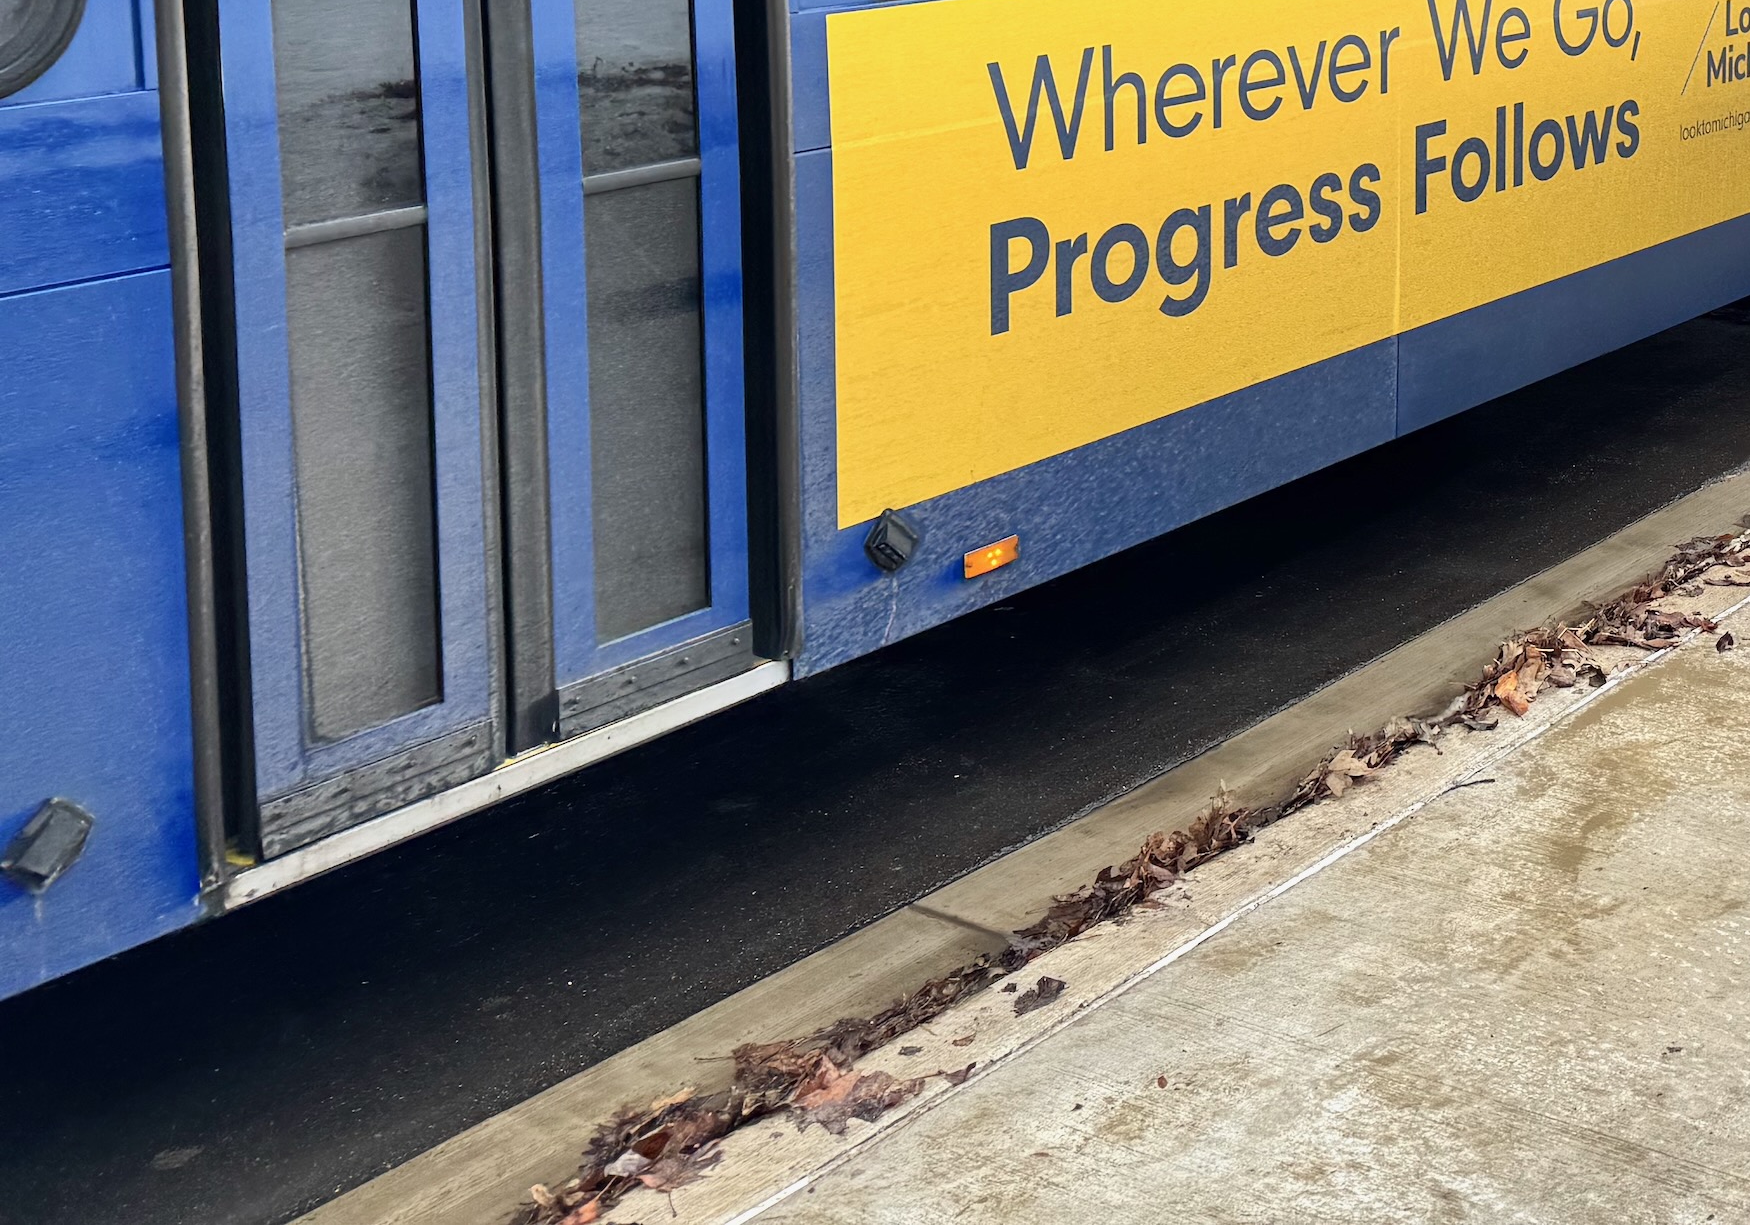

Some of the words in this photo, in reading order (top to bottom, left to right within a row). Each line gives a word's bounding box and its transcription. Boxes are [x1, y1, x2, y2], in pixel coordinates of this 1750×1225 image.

[987, 26, 1399, 170] Wherever
[990, 163, 1381, 336] Progress
[1415, 99, 1640, 216] Follows
